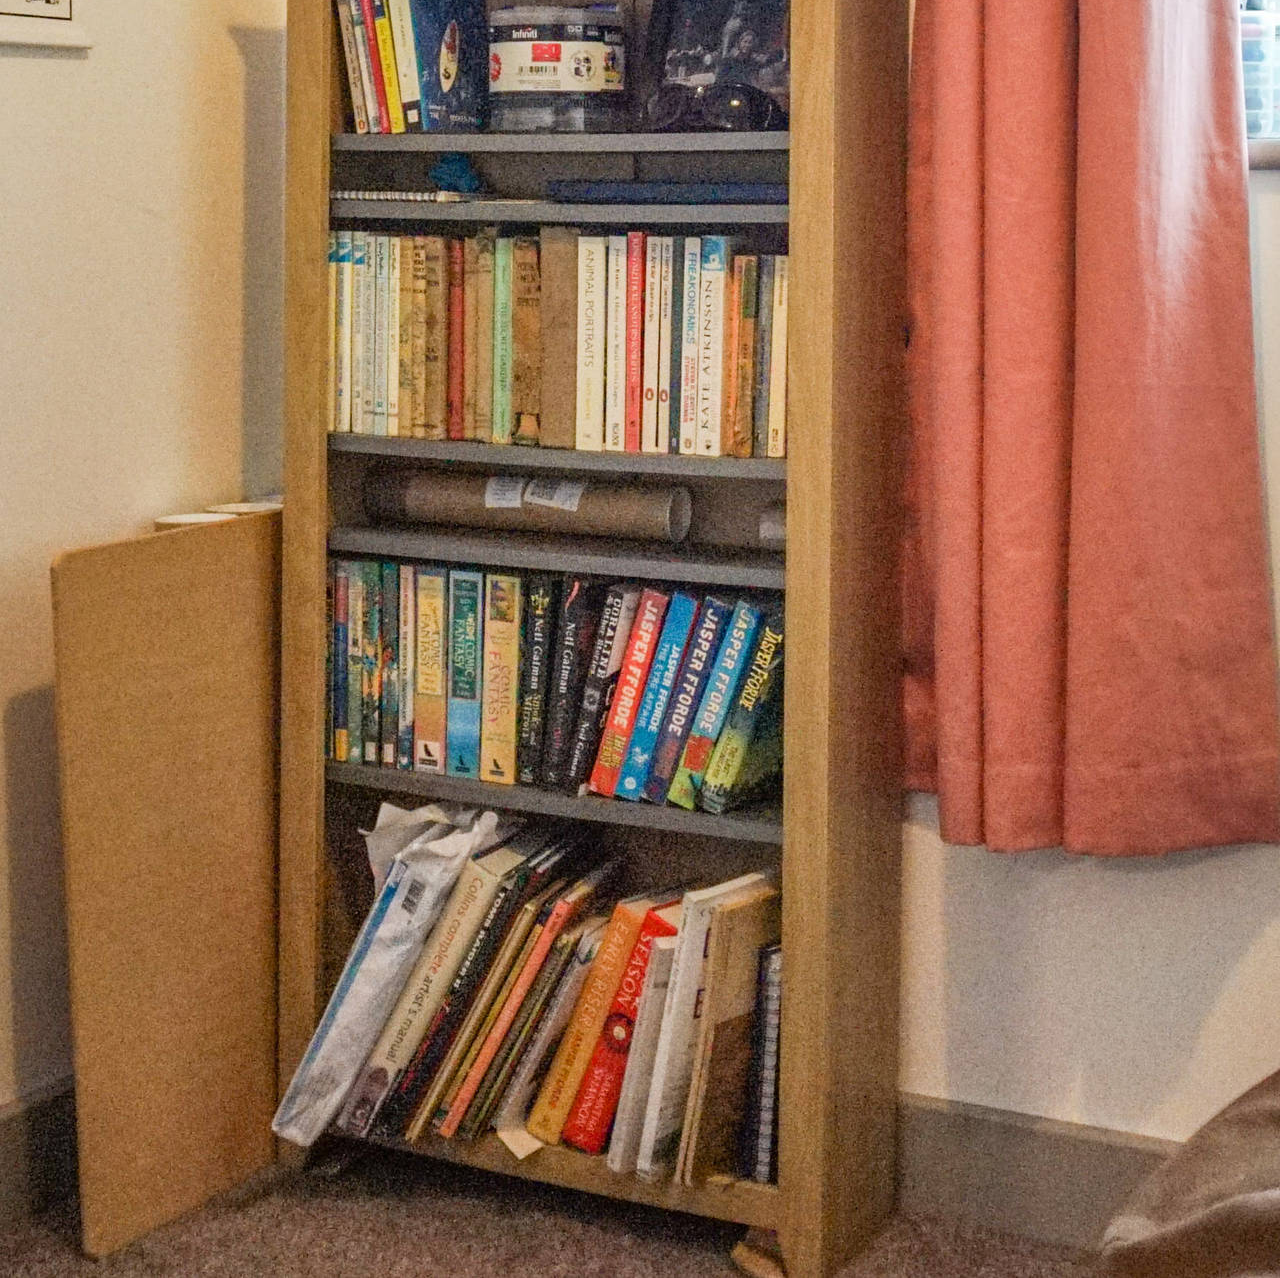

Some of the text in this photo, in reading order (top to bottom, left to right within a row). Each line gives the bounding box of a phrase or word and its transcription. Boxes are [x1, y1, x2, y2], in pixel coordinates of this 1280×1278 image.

[584, 248, 595, 297] ANIMAL
[686, 252, 698, 344] FREAKONOMICS
[584, 300, 595, 368] PORTRAITS
[701, 280, 712, 429] KATE ATKINSON
[420, 613, 432, 669] FANTASY
[453, 618, 465, 669] FANTASY
[465, 642, 475, 677] COMIC
[531, 618, 544, 690] Neil Gaiman
[564, 622, 576, 647] Neil
[596, 597, 622, 679] CORALINE
[721, 609, 750, 670] JASPER
[488, 651, 501, 723] FANTASY
[500, 664, 512, 715] COMIC
[559, 649, 573, 694] Gaiman
[614, 599, 659, 729] JASPER FFORDE
[664, 644, 681, 687] JASPER
[669, 608, 719, 737] JASPER FFORDE
[739, 626, 783, 712] JASPER FFORDE
[648, 687, 668, 733] FFORDE
[700, 672, 729, 733] FFORDE
[570, 722, 590, 778] Neil Gaiman
[460, 876, 484, 919] Collins
[484, 891, 506, 928] TOMB
[431, 919, 462, 973] complete
[459, 929, 485, 977] RAIDER
[617, 930, 650, 1011] SEASON
[408, 975, 433, 1015] artist's
[579, 920, 628, 1029] EARLY RISER
[386, 1018, 413, 1063] manual
